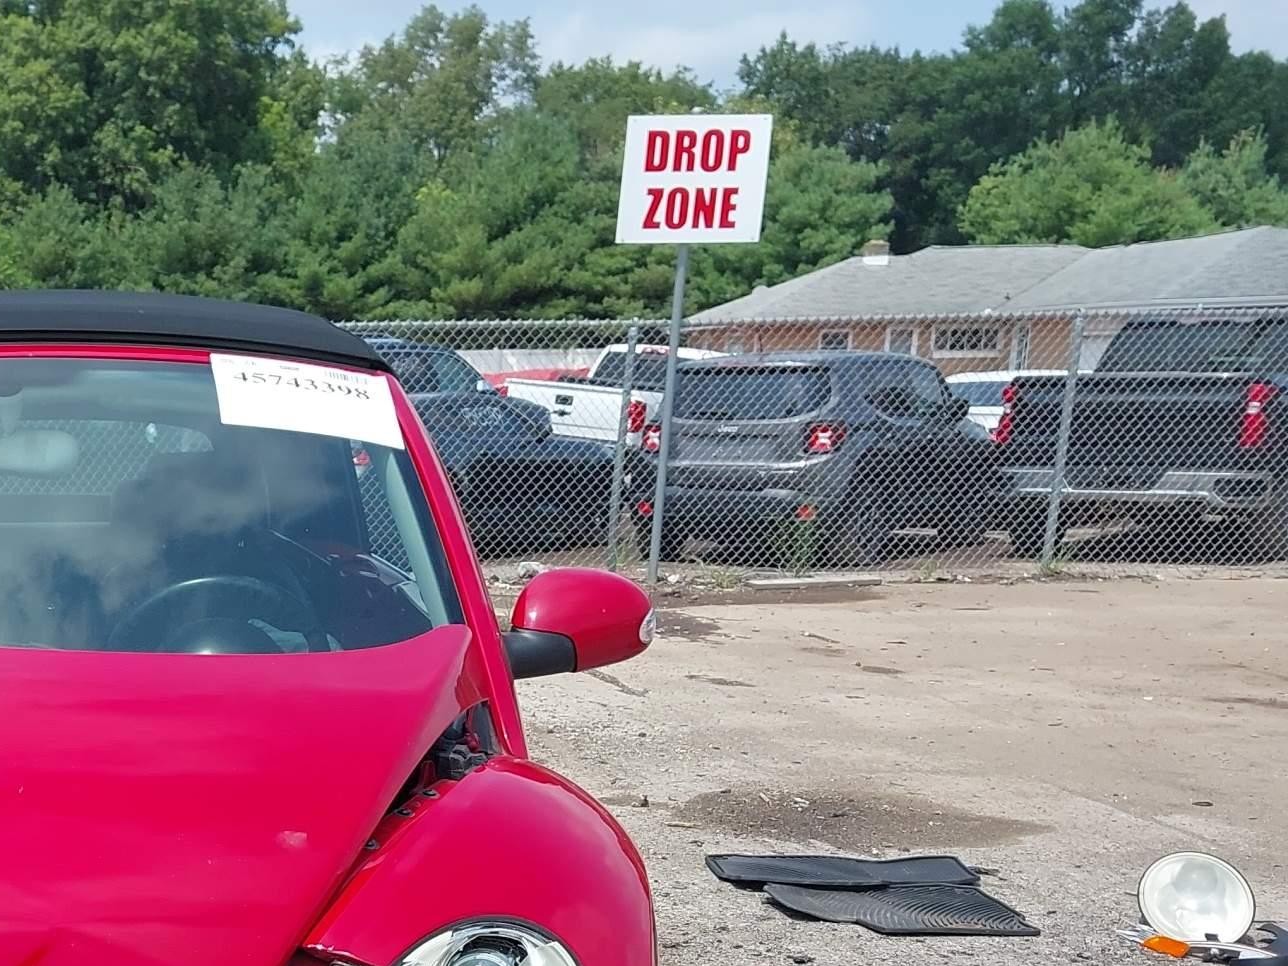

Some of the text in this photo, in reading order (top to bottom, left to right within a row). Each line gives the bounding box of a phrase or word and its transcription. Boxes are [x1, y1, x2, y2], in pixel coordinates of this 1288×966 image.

[644, 129, 750, 172] DROP
[642, 187, 738, 230] ZONE
[232, 371, 371, 400] 45743398
